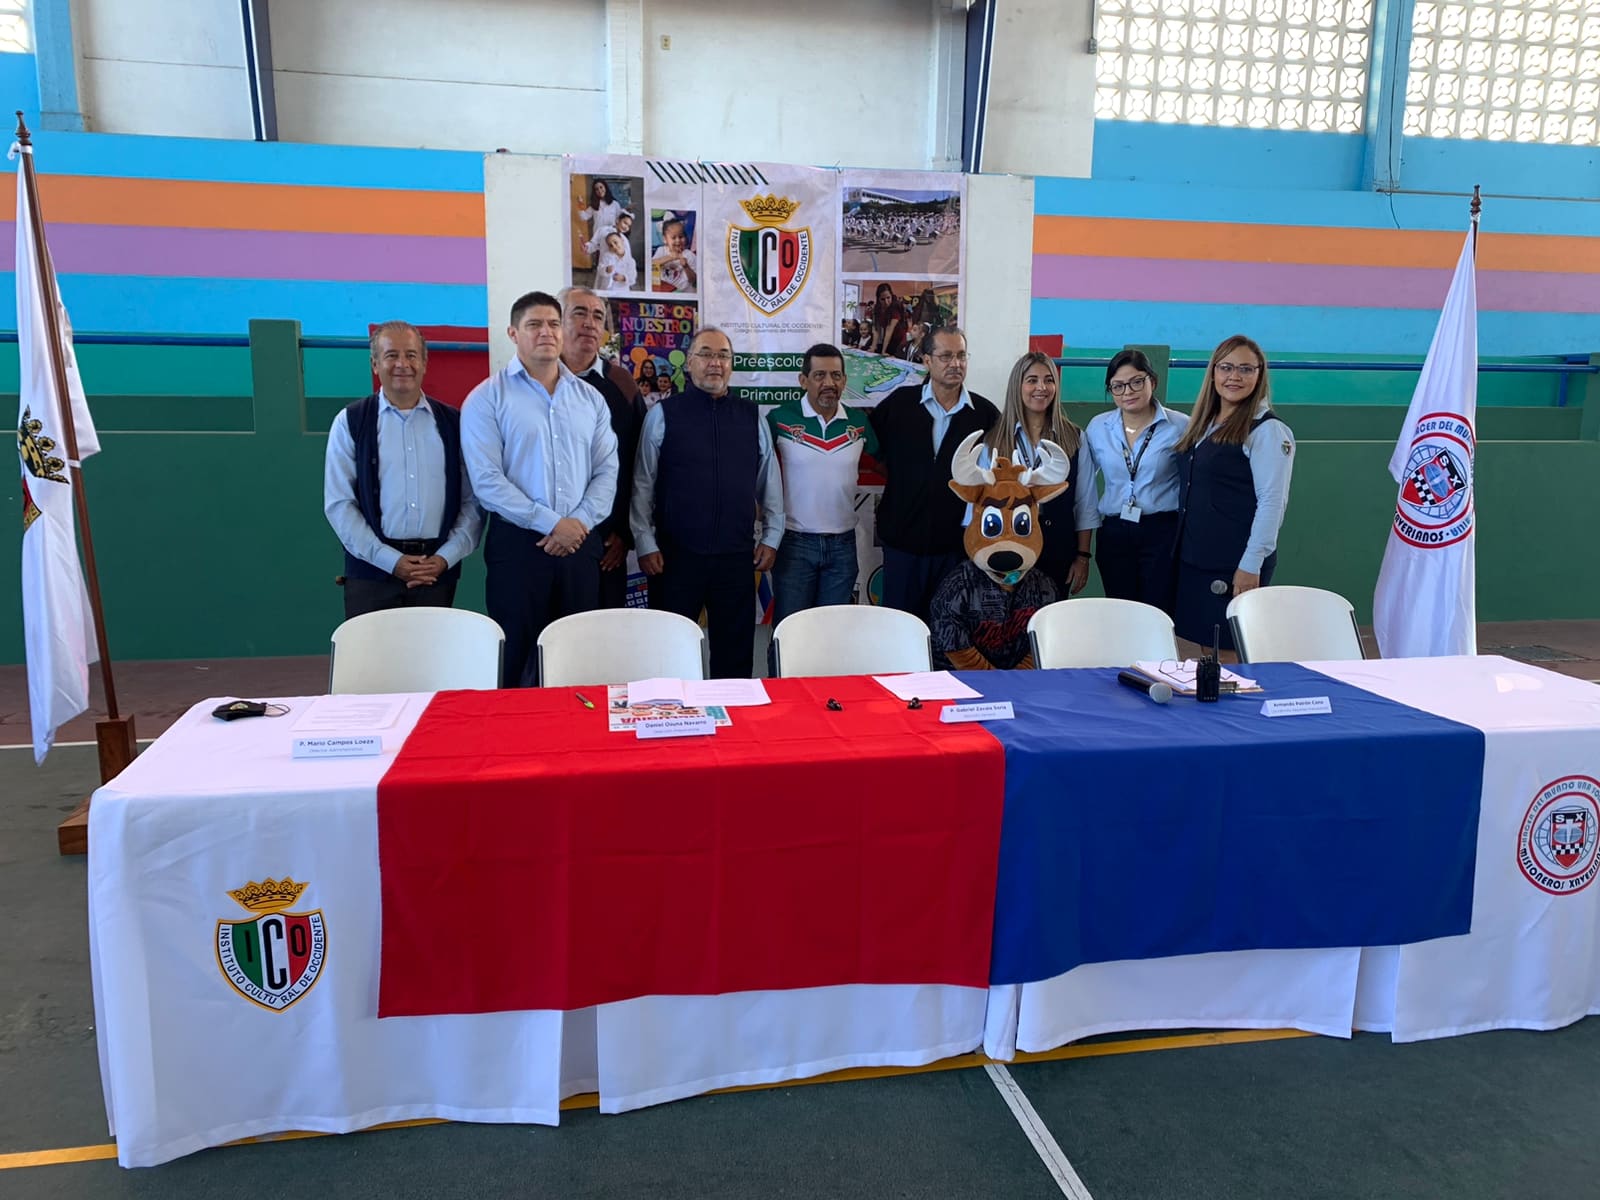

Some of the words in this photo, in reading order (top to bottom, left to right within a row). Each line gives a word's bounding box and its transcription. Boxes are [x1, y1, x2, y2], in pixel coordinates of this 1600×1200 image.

[731, 231, 746, 285] INSTITUTO
[786, 284, 797, 295] DE
[795, 233, 808, 282] OCCIDENTE
[622, 316, 692, 334] NUESTRO
[740, 388, 801, 401] Primaria
[1438, 420, 1453, 431] DEL
[1544, 782, 1575, 800] MUNDO
[1577, 781, 1592, 791] UNA
[1520, 847, 1565, 890] MISIONEROS
[220, 928, 246, 985] INSTITUTO
[300, 974, 313, 987] DE
[308, 916, 323, 972] OCCIDENTE
[244, 919, 307, 990] ICO
